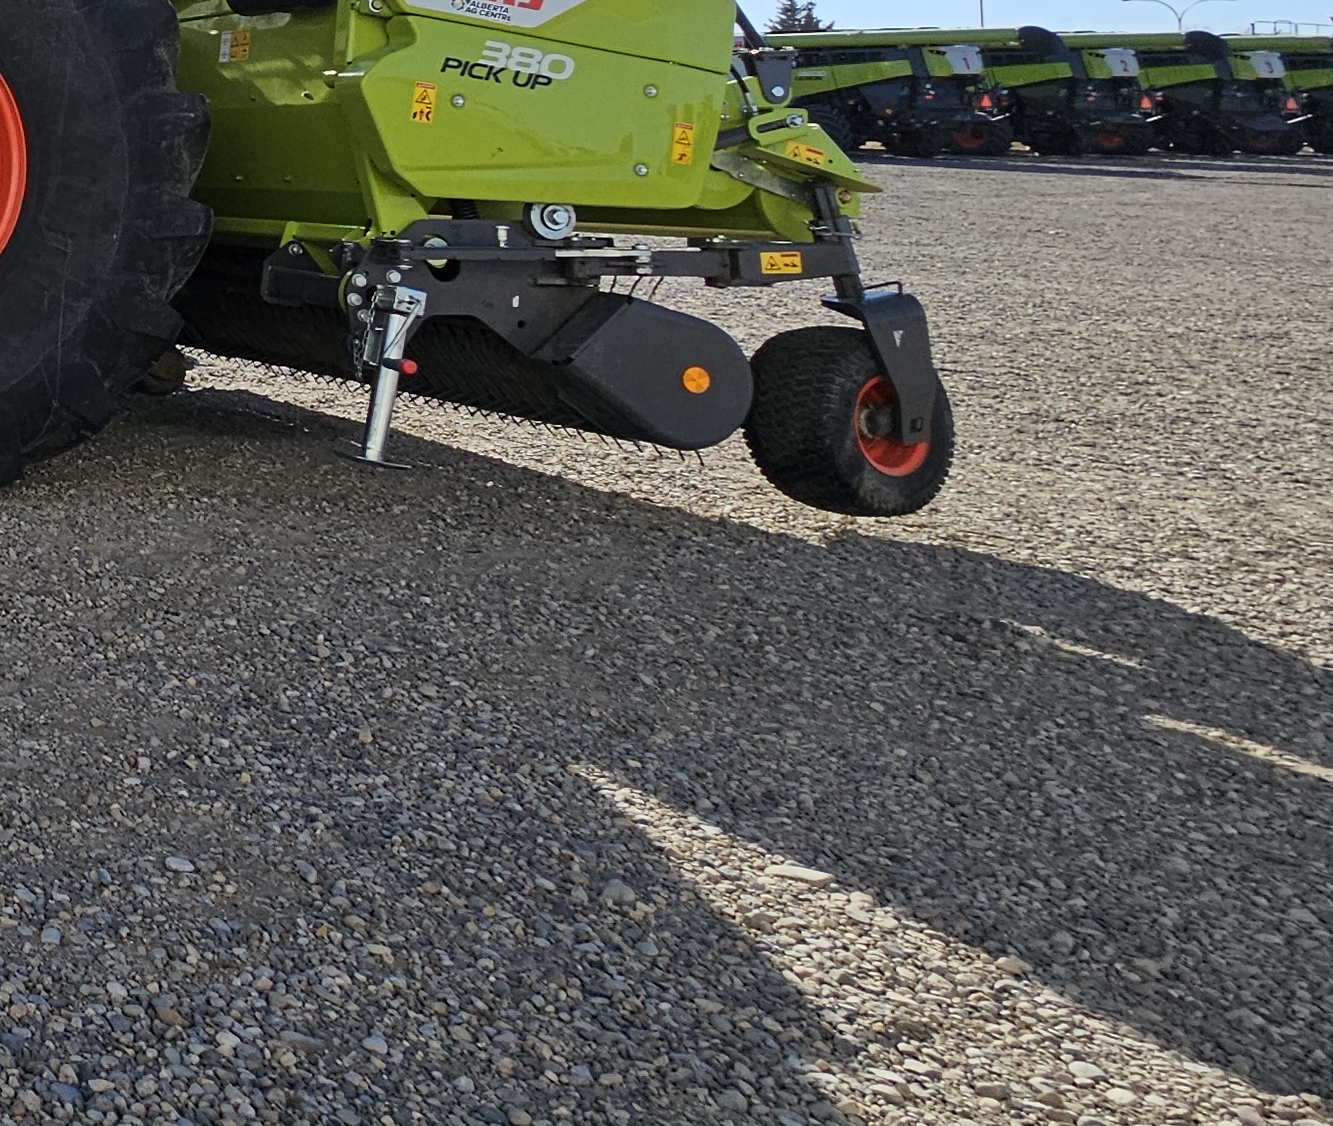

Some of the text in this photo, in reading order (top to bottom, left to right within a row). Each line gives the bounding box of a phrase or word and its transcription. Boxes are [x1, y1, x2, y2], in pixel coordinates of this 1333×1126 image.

[470, 0, 509, 14] ALBERTA
[440, 56, 552, 89] PICK UP
[478, 40, 575, 80] 380
